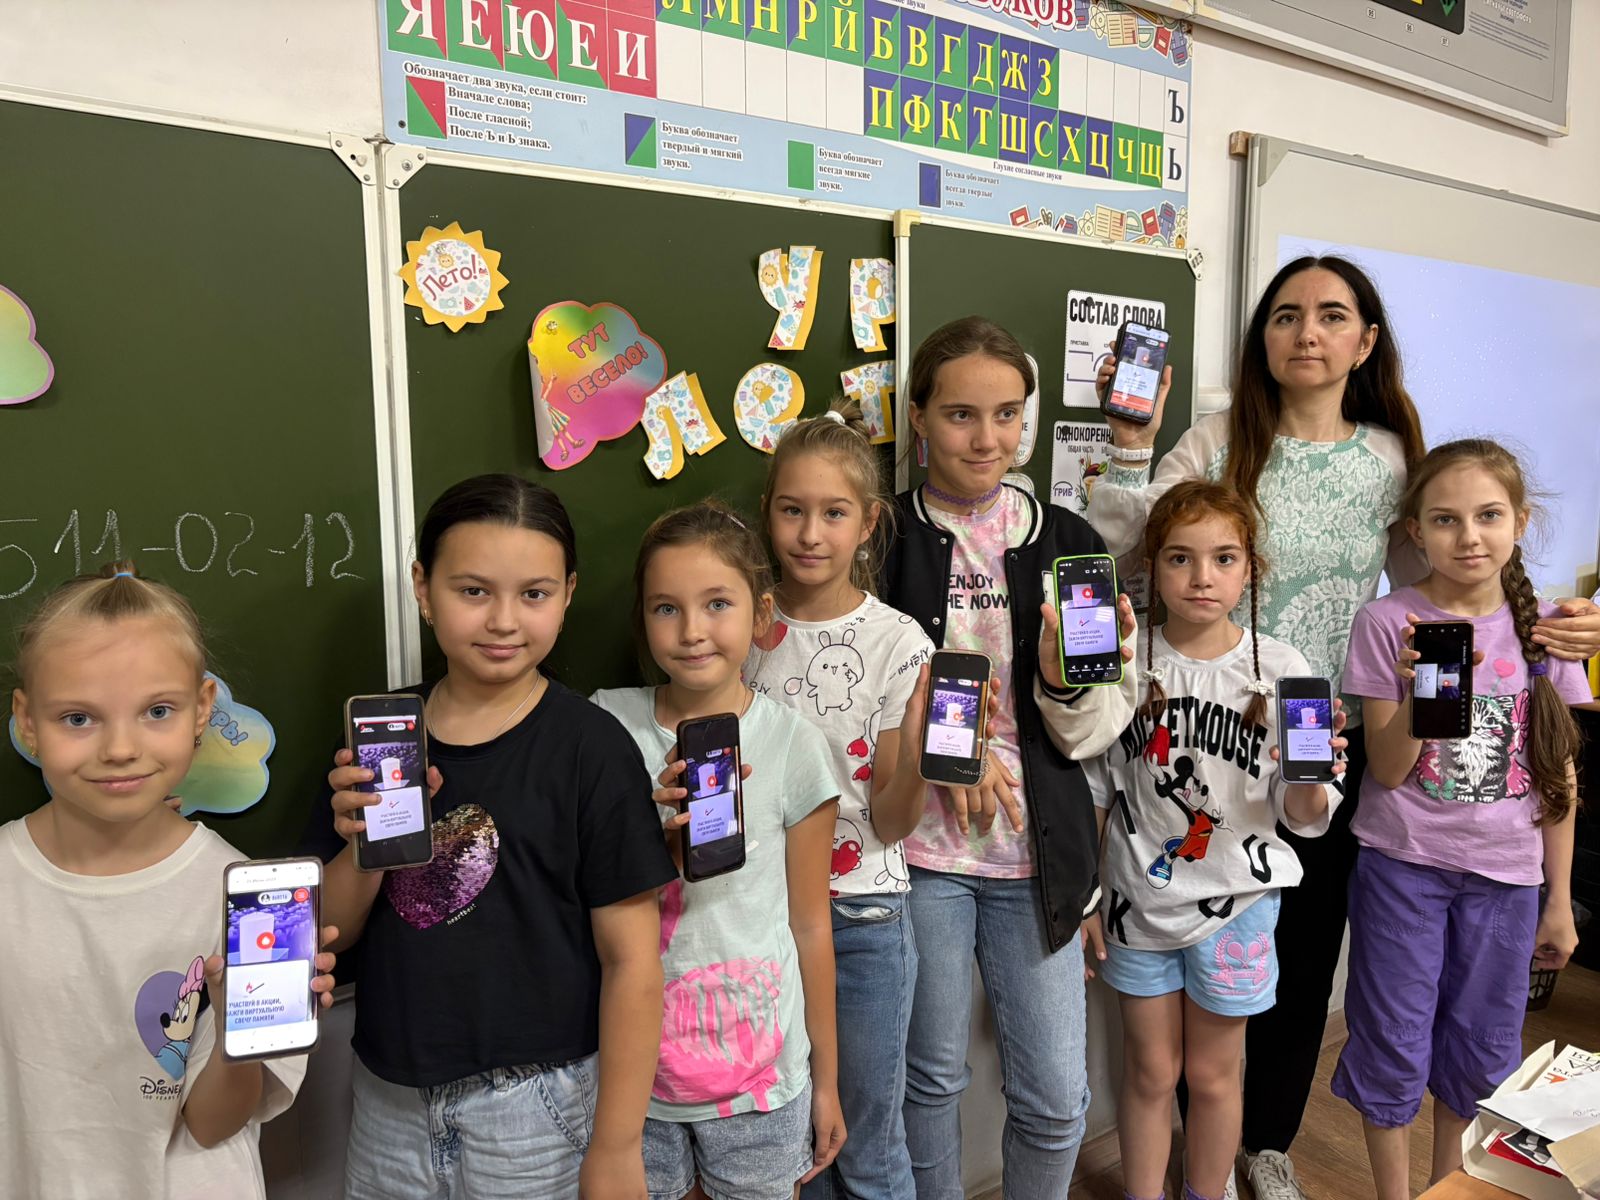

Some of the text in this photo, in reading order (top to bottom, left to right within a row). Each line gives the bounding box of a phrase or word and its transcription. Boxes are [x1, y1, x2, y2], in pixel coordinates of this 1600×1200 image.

[396, 0, 438, 40] Я
[505, 4, 555, 61] Ю
[567, 18, 598, 71] Е
[614, 28, 650, 81] И
[751, 0, 780, 34] Н
[795, 0, 817, 41] Р
[831, 0, 859, 53] Й
[871, 16, 894, 60] Б
[907, 25, 928, 67] В
[941, 33, 961, 74] Г
[972, 42, 994, 93] Д
[1001, 50, 1028, 92] Ж
[1037, 58, 1052, 97] З
[403, 62, 587, 104] Обозначает два звука, если стоит:
[448, 86, 531, 111] Вначале слова;
[1168, 88, 1184, 124] Ъ
[449, 105, 531, 129] После гласной;
[450, 125, 483, 140] После
[498, 134, 505, 142] и
[518, 137, 550, 149] знака.
[662, 122, 739, 144] Буква обозначает
[868, 85, 1161, 185] П Ф К Т Ш С Х Ц Ч Щ
[662, 141, 742, 161] твердый и мягкий
[662, 157, 690, 169] звуки.
[819, 148, 882, 167] Буква обозначает
[819, 165, 871, 181] всегда мягкие
[945, 169, 965, 180] Буква
[993, 161, 1014, 173] Глухие
[1015, 167, 1045, 178] согласные
[1168, 147, 1182, 181] Ь
[819, 181, 842, 192] звуки.
[422, 254, 478, 302] Лето!
[1069, 298, 1119, 327] СОСТАВ
[568, 322, 610, 359] ТУТ
[567, 341, 649, 405] ВЕСЕЛО!
[1053, 487, 1073, 497] ГРИБ
[947, 573, 994, 590] ENJOY
[970, 593, 1009, 610] NOW
[209, 704, 249, 746] РЬ!
[229, 1000, 255, 1008] УЧАСТВУЙ
